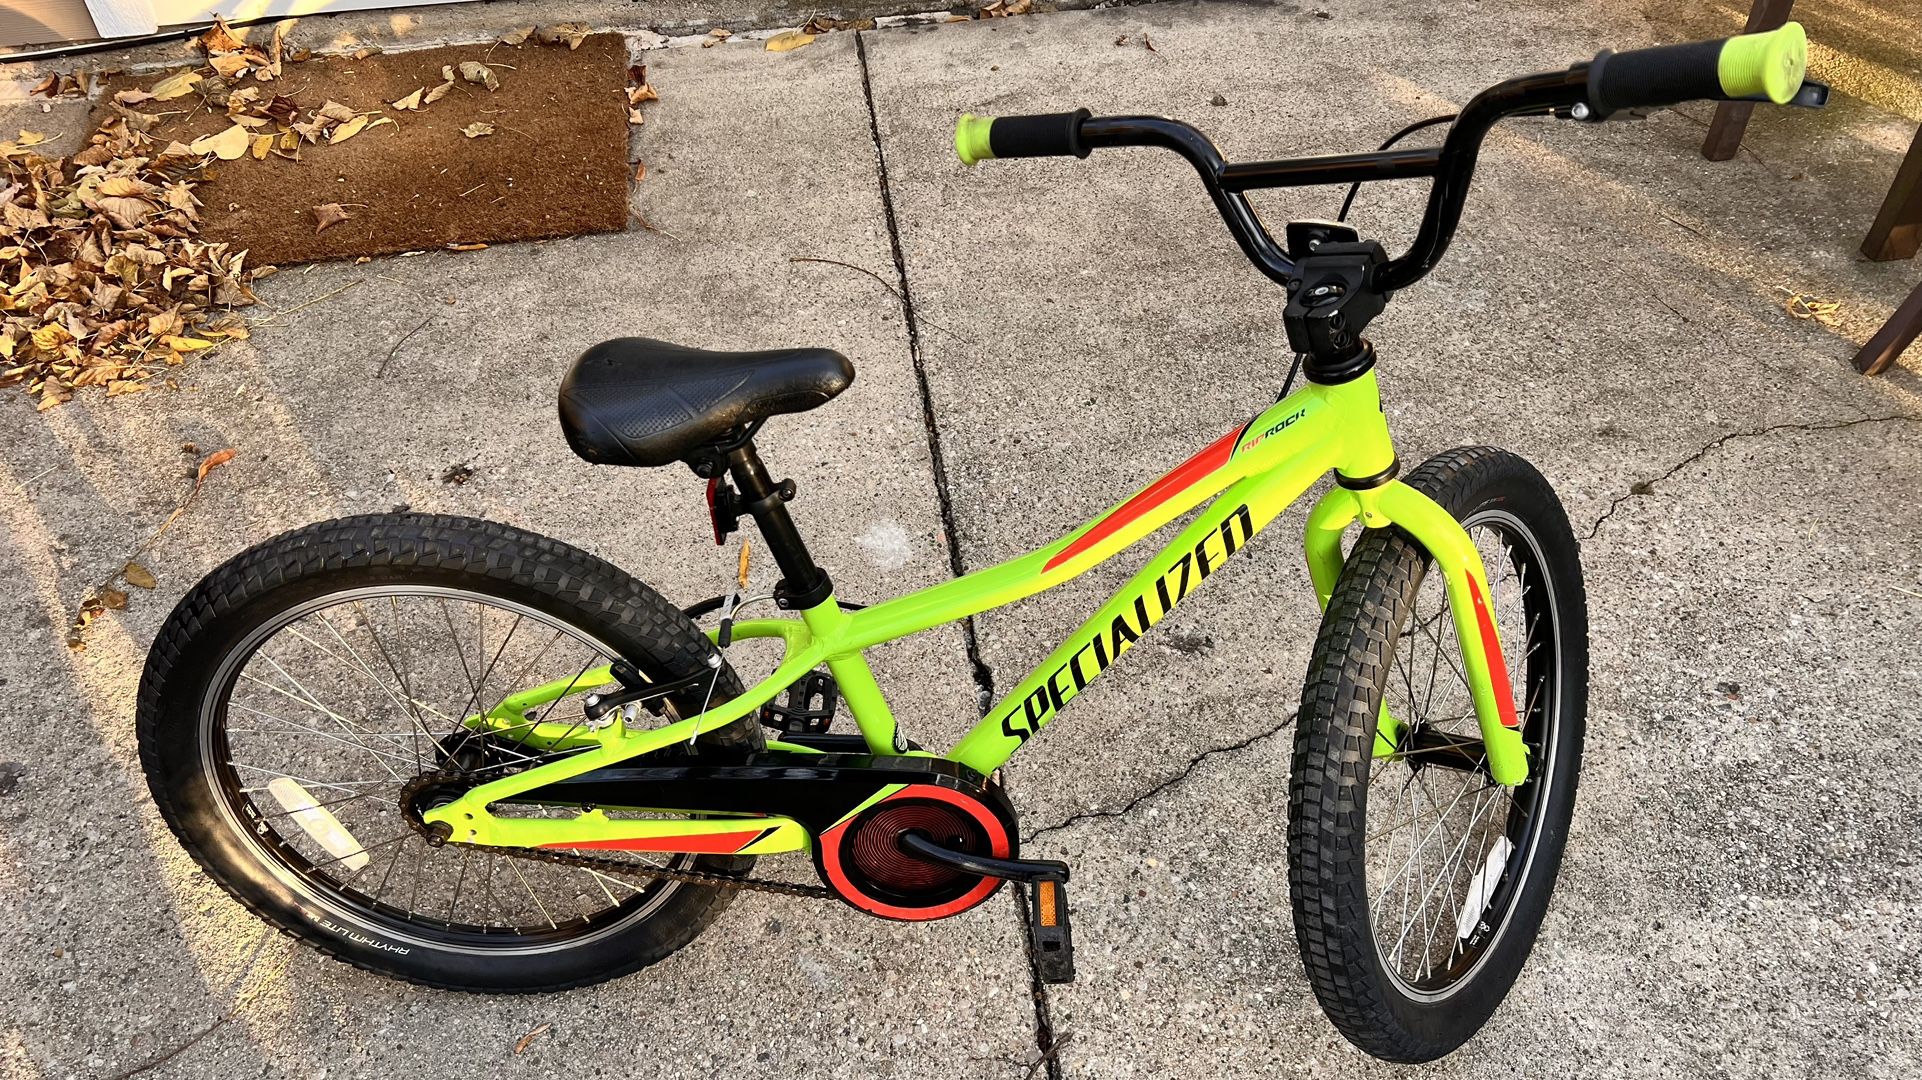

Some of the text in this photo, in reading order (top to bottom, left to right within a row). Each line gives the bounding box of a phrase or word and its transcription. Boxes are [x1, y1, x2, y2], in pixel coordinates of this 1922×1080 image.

[1241, 408, 1306, 453] RIPROCK
[1001, 503, 1254, 755] SPECIALIZED
[319, 920, 411, 956] RHYTHM LITE
